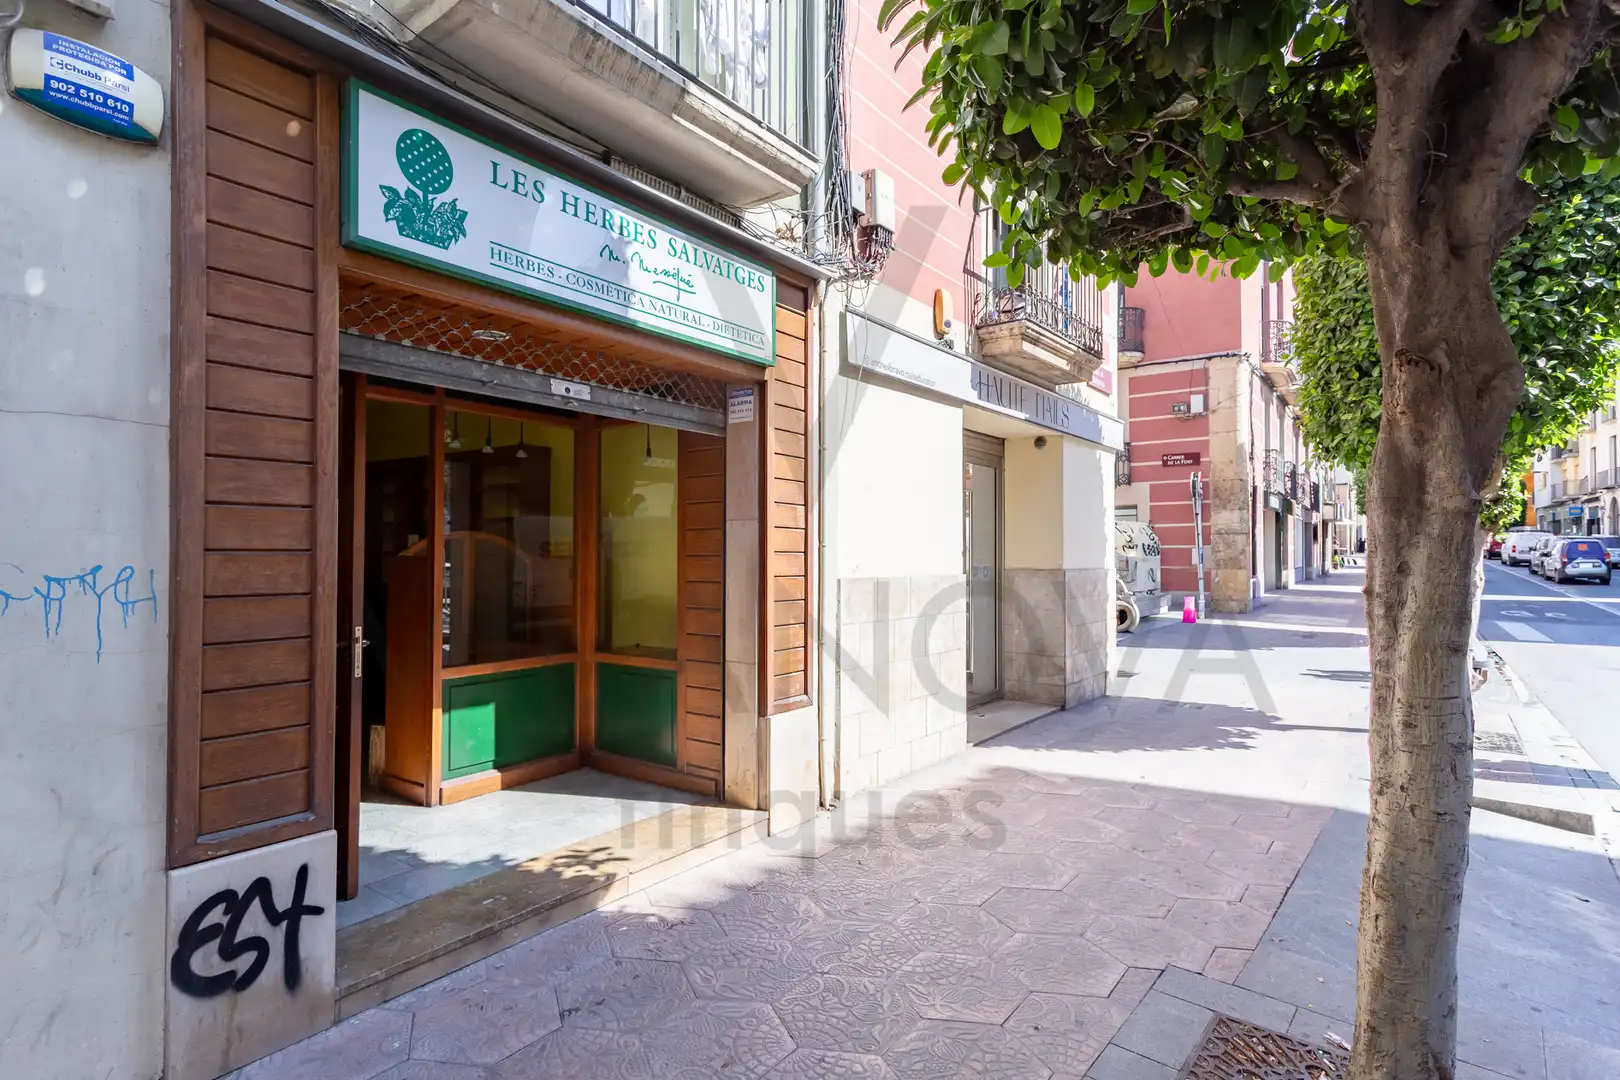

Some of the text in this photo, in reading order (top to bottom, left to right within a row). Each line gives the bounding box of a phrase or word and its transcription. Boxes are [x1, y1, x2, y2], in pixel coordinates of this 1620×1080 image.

[52, 44, 127, 76] PROTEGIDA POR
[64, 63, 102, 81] Chubb
[104, 76, 130, 93] Parsi
[48, 91, 130, 120] www.chubbparsi.com
[49, 80, 75, 94] 902
[79, 89, 103, 103] 510
[107, 98, 129, 113] 610
[489, 159, 765, 293] LES HERBES SALVATGES
[490, 246, 556, 279] HERBES
[565, 272, 646, 308] COSMÈTICA
[648, 299, 706, 328] NATURAL
[729, 399, 753, 407] ALARMA
[1035, 392, 1070, 430] NAILS
